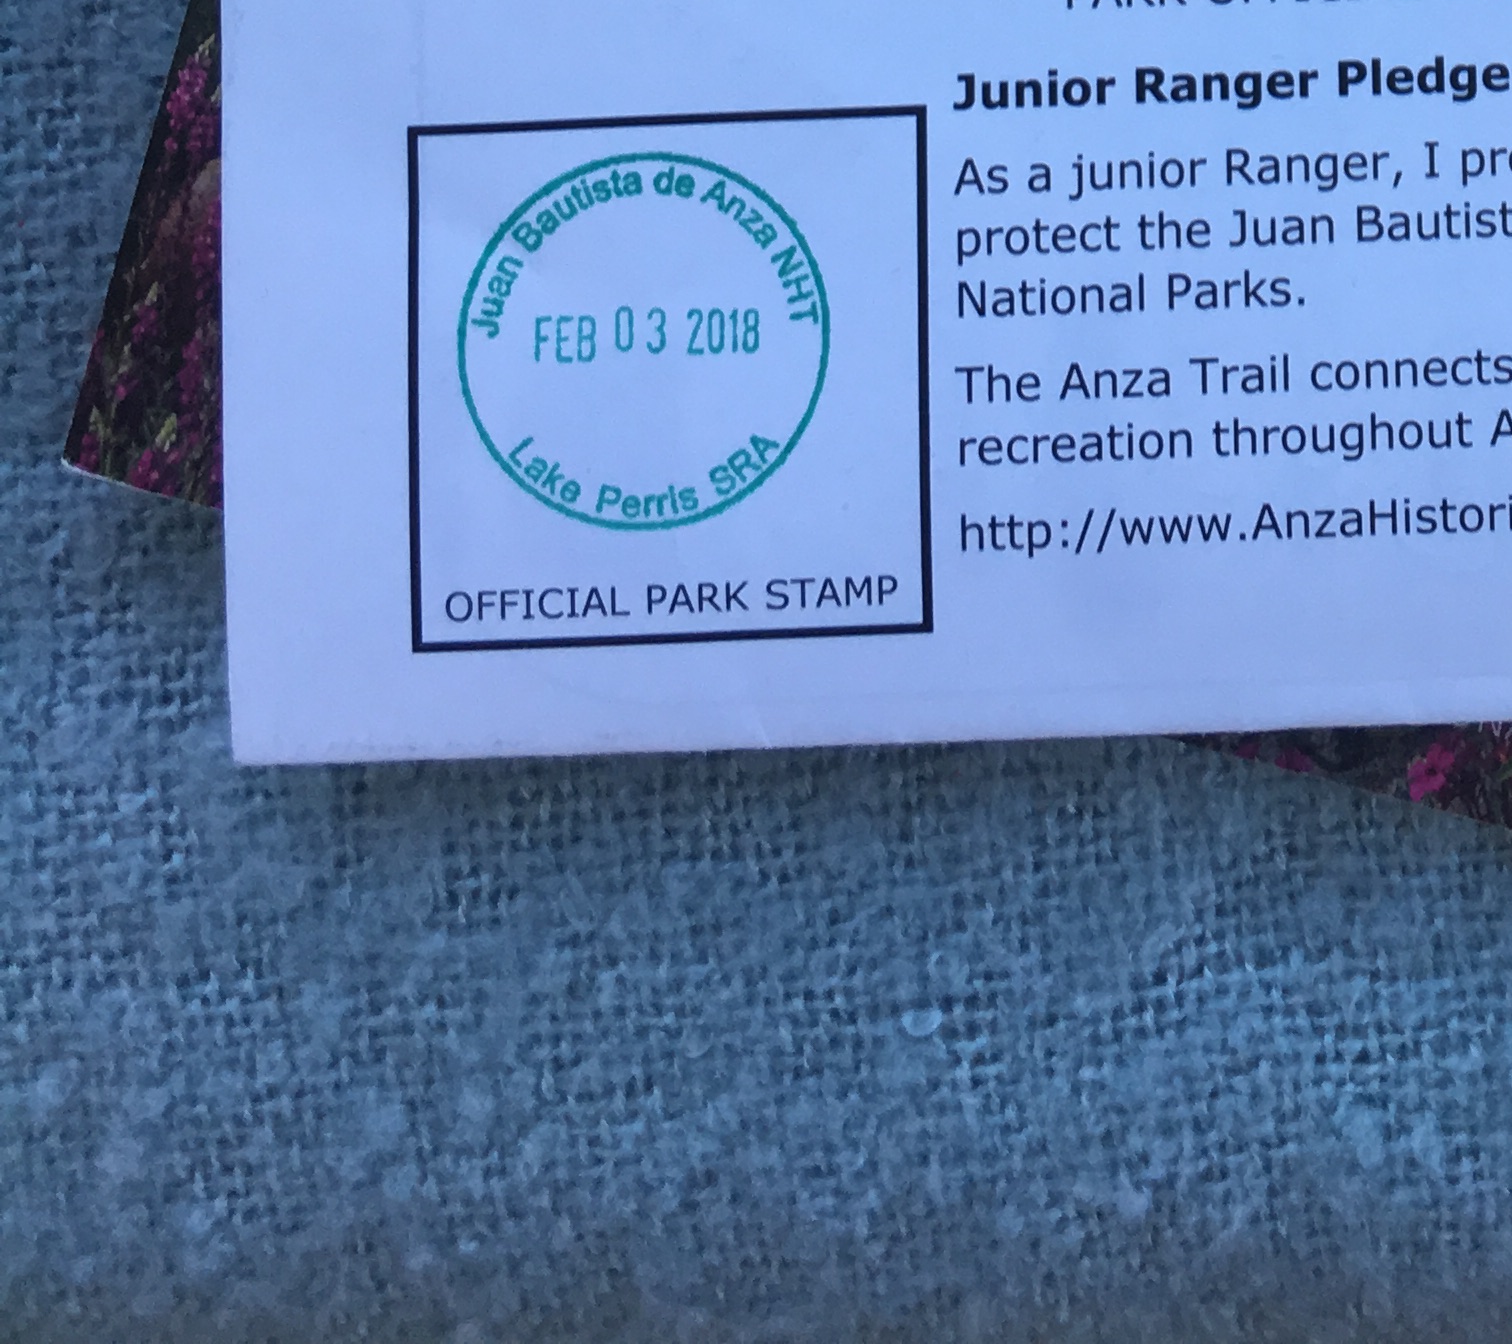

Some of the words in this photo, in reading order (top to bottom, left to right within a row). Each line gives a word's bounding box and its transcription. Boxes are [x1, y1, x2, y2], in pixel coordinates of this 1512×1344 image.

[951, 67, 1118, 113] Junior
[1133, 65, 1320, 112] Ranger
[952, 156, 1010, 197] As
[1026, 161, 1053, 195] a
[1067, 149, 1209, 203] junior
[1224, 146, 1404, 194] Ranger,
[1422, 139, 1441, 181] I
[472, 252, 524, 340] Juan
[510, 167, 644, 253] Bautista
[653, 165, 696, 200] de
[700, 177, 778, 250] Anza
[770, 243, 820, 327] NHT
[955, 214, 1122, 268] protect
[1136, 209, 1212, 252] the
[1227, 208, 1336, 249] Juan
[956, 271, 1146, 320] National
[1166, 267, 1307, 312] Parks.
[533, 314, 597, 364] FEB
[686, 307, 761, 355] 2018
[953, 362, 1042, 406] The
[1058, 360, 1172, 402] Anza
[1187, 351, 1291, 397] Trail
[958, 421, 1194, 468] recreation
[1211, 410, 1475, 463] throughout
[507, 435, 582, 504] Lake
[596, 484, 700, 519] Perris
[708, 431, 780, 496] SRA
[444, 584, 632, 624] OFFICIAL
[645, 579, 750, 617] PARK
[764, 573, 899, 612] STAMP
